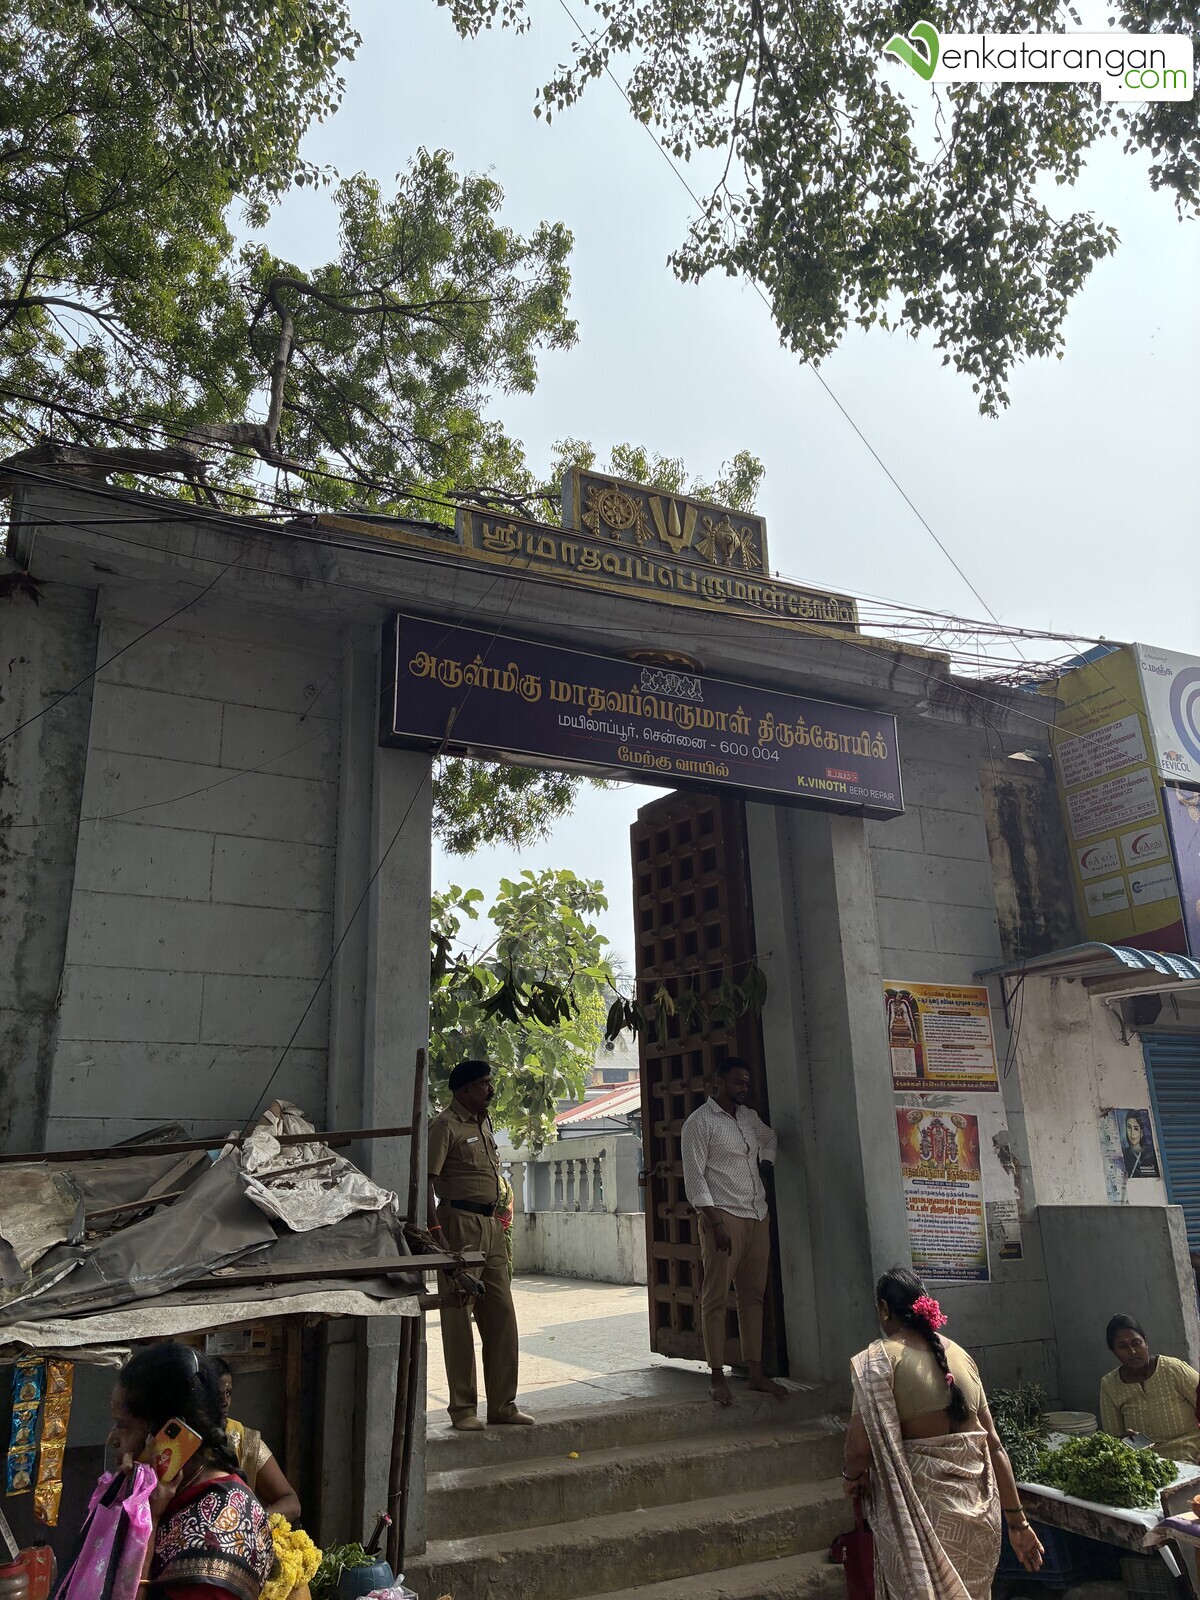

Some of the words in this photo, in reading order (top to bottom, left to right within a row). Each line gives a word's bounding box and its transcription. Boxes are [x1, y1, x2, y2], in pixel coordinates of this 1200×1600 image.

[408, 651, 542, 702] அருள்மிகு
[549, 679, 752, 736] மாதவப்பெருமாள்
[757, 712, 888, 760] திருக்கோயில்
[558, 714, 639, 742] மயிலாப்பூர்,
[643, 729, 707, 749] சென்னை
[720, 741, 748, 756] 600
[752, 745, 780, 762] 004
[617, 746, 672, 771] மேற்கு
[676, 759, 730, 777] வாயில்
[1161, 760, 1191, 772] FEVICOL
[797, 775, 847, 793] K.VINOTH
[849, 786, 869, 797] BERO
[870, 790, 895, 801] REPAIR
